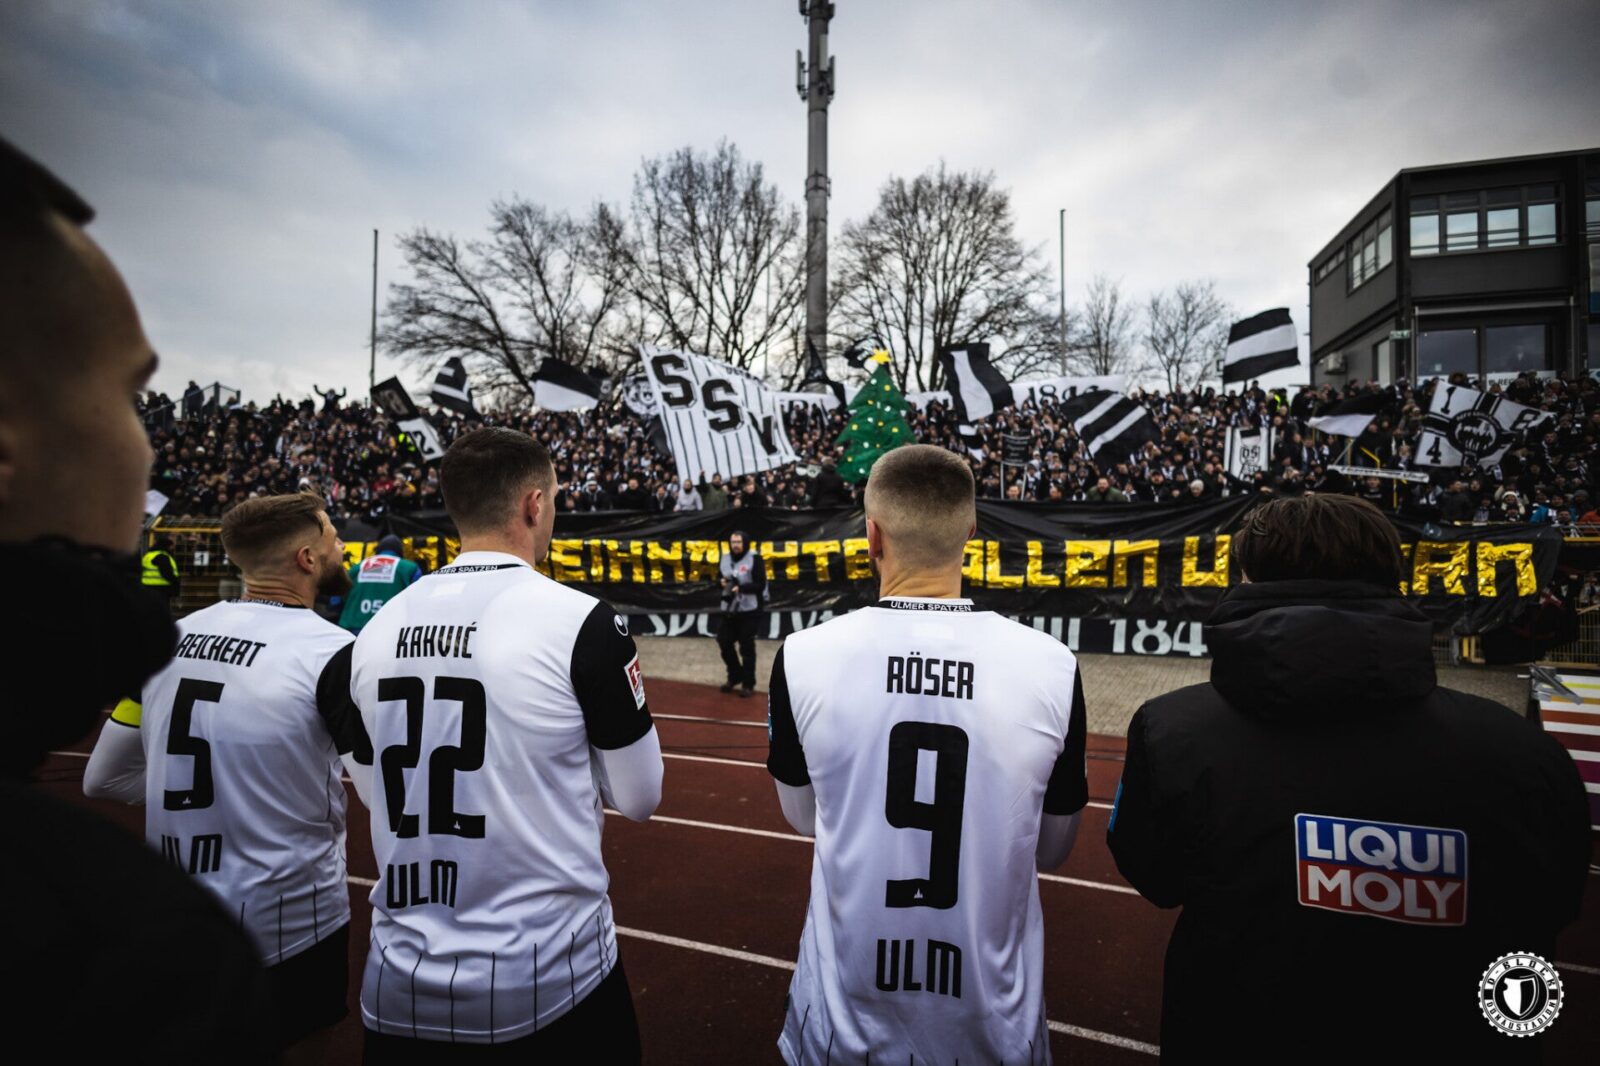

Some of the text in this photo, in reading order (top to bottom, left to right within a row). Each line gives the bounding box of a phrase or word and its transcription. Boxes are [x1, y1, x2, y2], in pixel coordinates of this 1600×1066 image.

[651, 354, 778, 456] SSV
[458, 564, 498, 574] SPATZEN
[890, 600, 972, 613] ULMER SPATZEN
[173, 633, 267, 667] REICHERT
[396, 621, 477, 659] KAHVIĆ
[1110, 618, 1208, 657] 184
[887, 651, 974, 700] RÖSER
[163, 678, 225, 811] 5
[378, 676, 486, 839] 22
[885, 721, 969, 910] 9
[1305, 820, 1457, 875] LIQUI
[386, 859, 457, 909] ULM
[1308, 864, 1461, 919] MOLY
[876, 938, 962, 999] ULM
